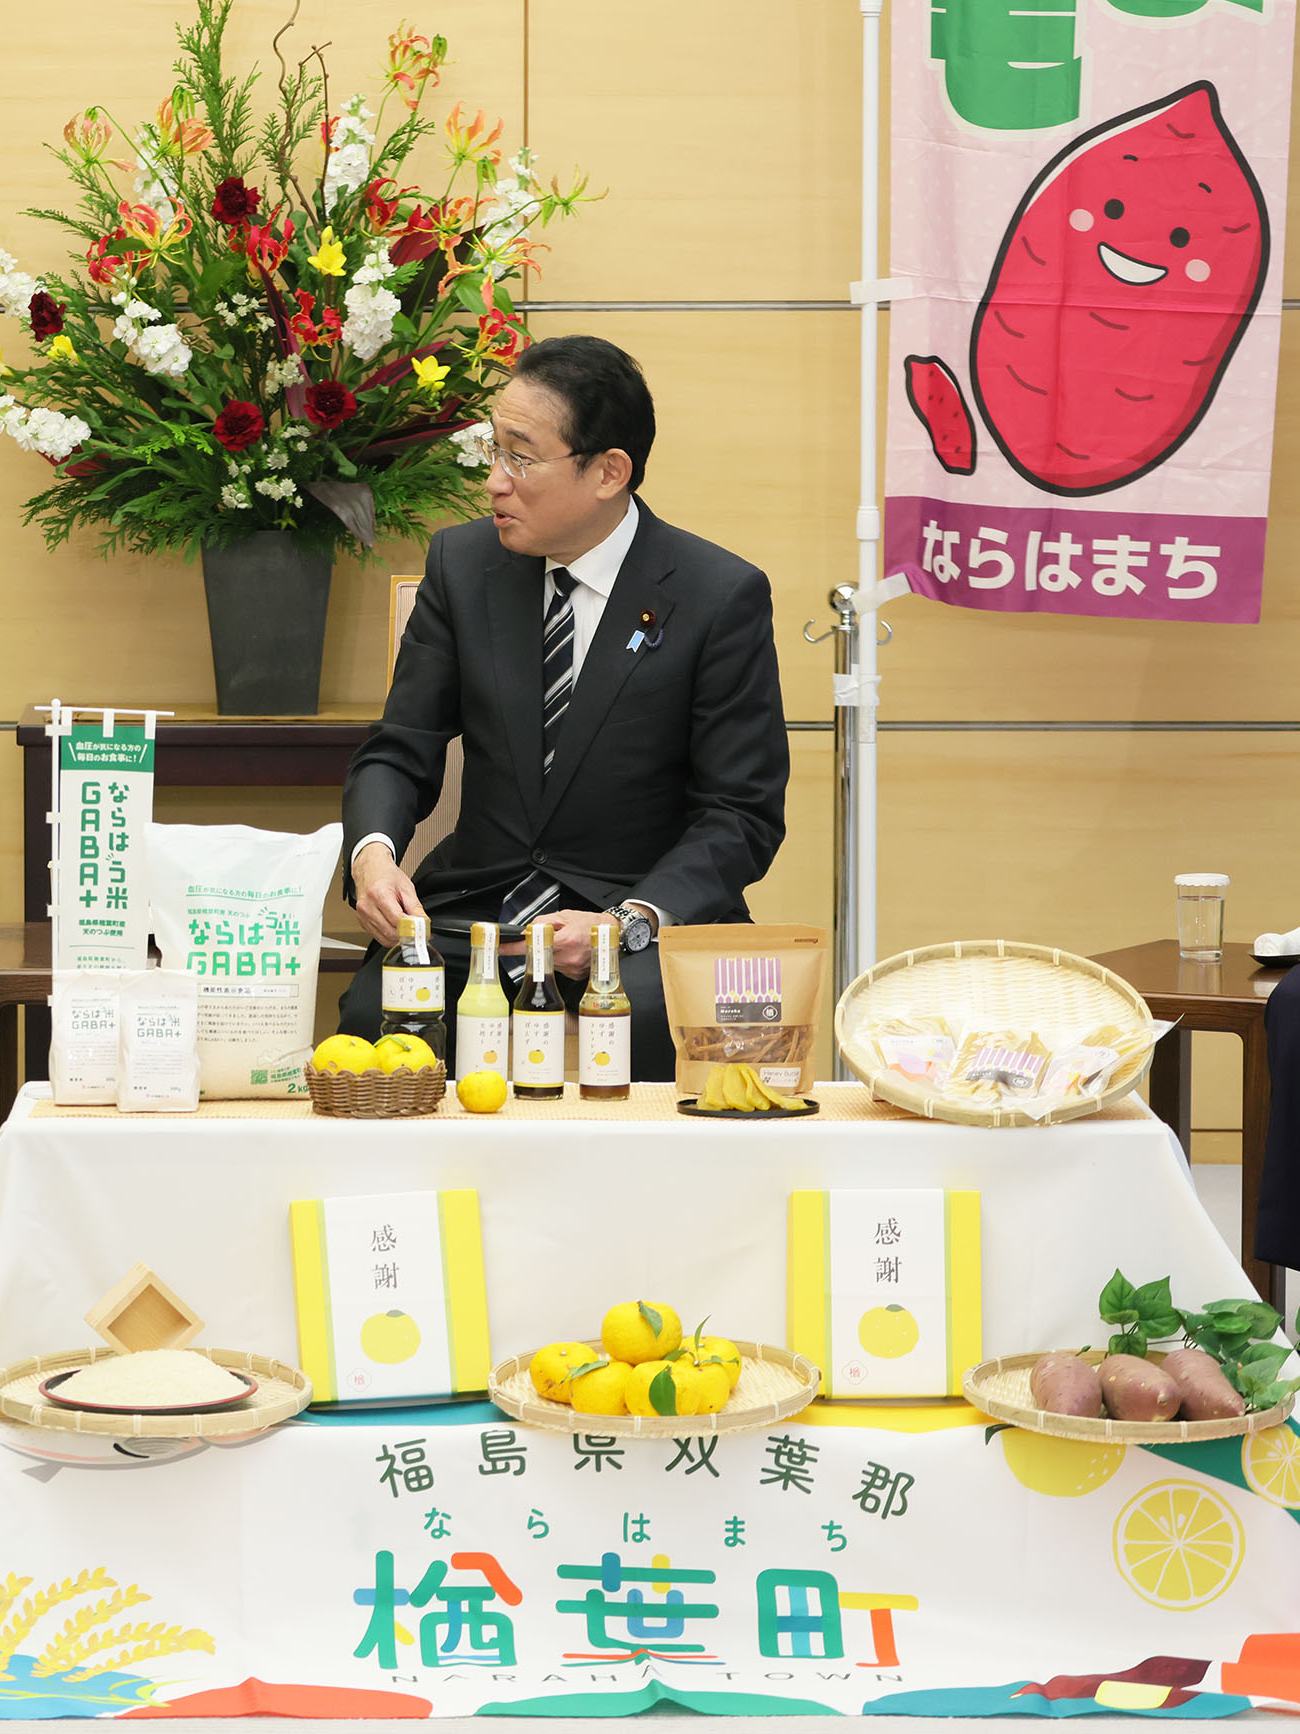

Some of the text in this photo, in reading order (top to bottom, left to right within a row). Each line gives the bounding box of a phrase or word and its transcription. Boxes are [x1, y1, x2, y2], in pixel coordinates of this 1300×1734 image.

[922, 520, 1221, 600] ならはまち
[79, 782, 101, 908] GABA+
[187, 951, 301, 976] GABA+
[71, 1019, 116, 1030] GABA+
[137, 1027, 182, 1038] GABA+
[371, 1223, 400, 1290] 感謝
[874, 1217, 903, 1284] 感謝
[375, 1429, 916, 1520] 福島県双葉郡
[423, 1506, 849, 1553] ならはまち
[352, 1550, 920, 1669] 楢葉町
[391, 1664, 906, 1685] NARAHA TOWN
